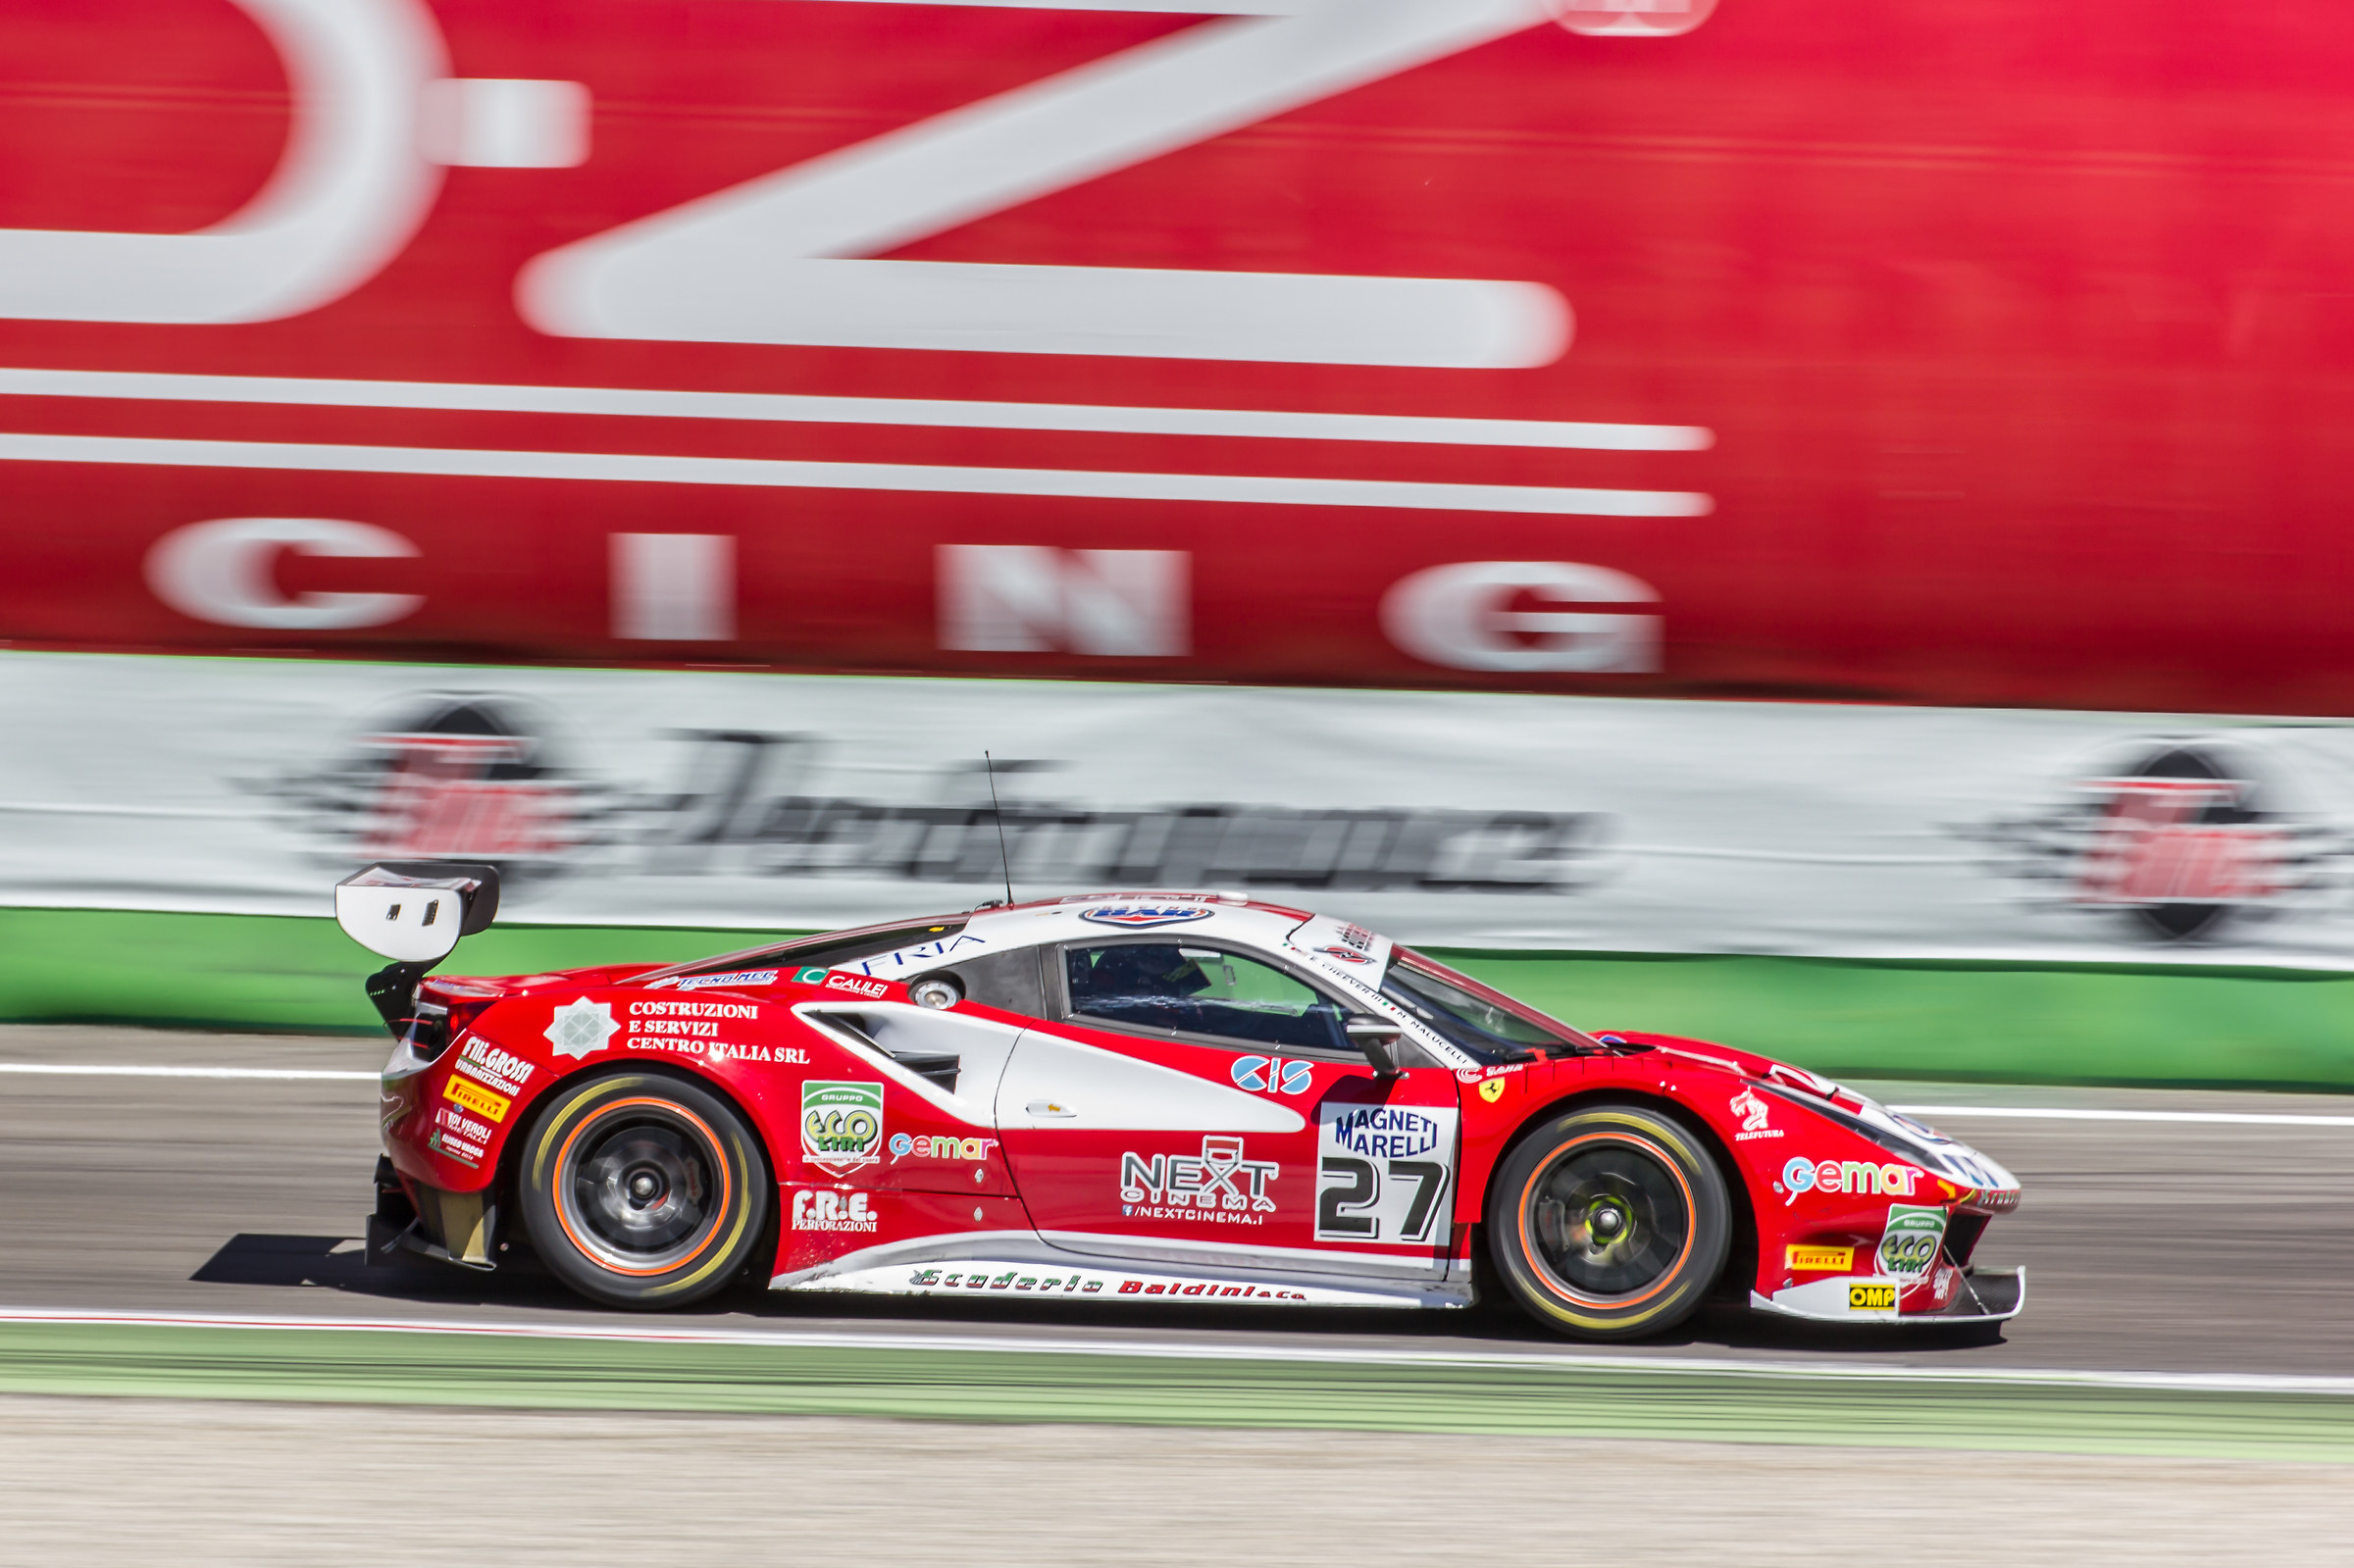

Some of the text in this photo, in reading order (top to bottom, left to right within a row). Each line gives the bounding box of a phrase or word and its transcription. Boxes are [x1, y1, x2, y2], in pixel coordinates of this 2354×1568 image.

[630, 1001, 758, 1020] COSTRUZIONI
[1321, 962, 1370, 995] CHEEVER
[1370, 993, 1383, 1003] III
[1410, 1020, 1468, 1065] MALUCELLI
[629, 1020, 719, 1037] E SERVIZI
[627, 1037, 810, 1065] CENTRO ITALIA SRL
[454, 1058, 522, 1097] URBANIZZAZIONI
[1231, 1055, 1315, 1095] CIS
[450, 1082, 502, 1116] PIRELLI
[821, 1093, 863, 1102] GRUPPO
[461, 1117, 492, 1141] VEROLI
[804, 1109, 879, 1144] ECO
[1335, 1108, 1438, 1147] MAGNETI
[1734, 1128, 1785, 1141] TELEFUTURA
[818, 1137, 865, 1152] LIRI
[1335, 1128, 1438, 1158] MARELLI
[1120, 1147, 1280, 1198] NEXT
[793, 1189, 878, 1222] F.R.E.
[1120, 1188, 1277, 1212] CINEMA
[1319, 1156, 1450, 1241] 27
[792, 1219, 878, 1233] PERFORAZIONI
[1903, 1218, 1935, 1228] GRUPPO
[1793, 1250, 1847, 1266] PIRELLI
[1880, 1234, 1937, 1262] ECO
[912, 1269, 1103, 1293] Scuderia
[1116, 1280, 1256, 1302] Baldini
[1850, 1287, 1896, 1307] OMP
